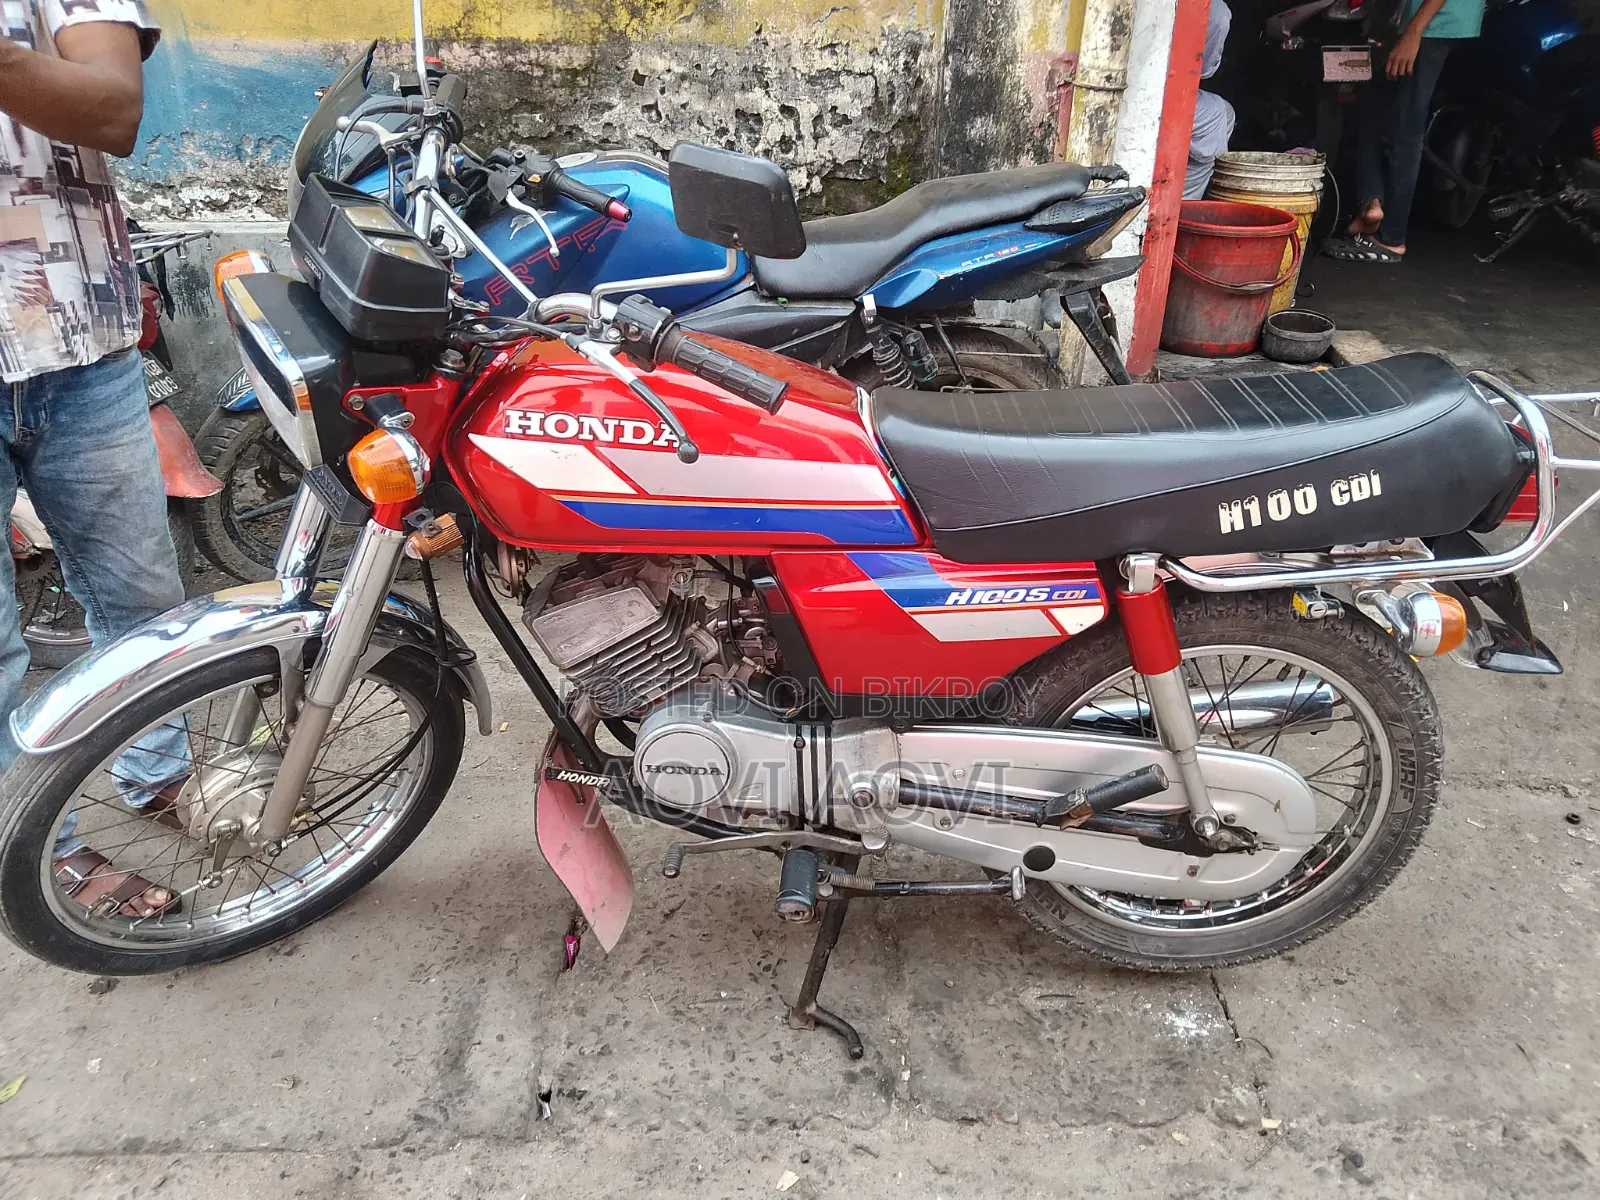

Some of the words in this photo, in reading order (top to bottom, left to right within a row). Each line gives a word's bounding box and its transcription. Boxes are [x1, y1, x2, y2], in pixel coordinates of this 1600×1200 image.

[505, 408, 680, 448] HONDA
[1219, 483, 1318, 535] H100
[1052, 589, 1088, 600] CDI
[557, 770, 611, 788] HONDA
[645, 764, 725, 777] HONDA
[1398, 749, 1416, 803] MRF
